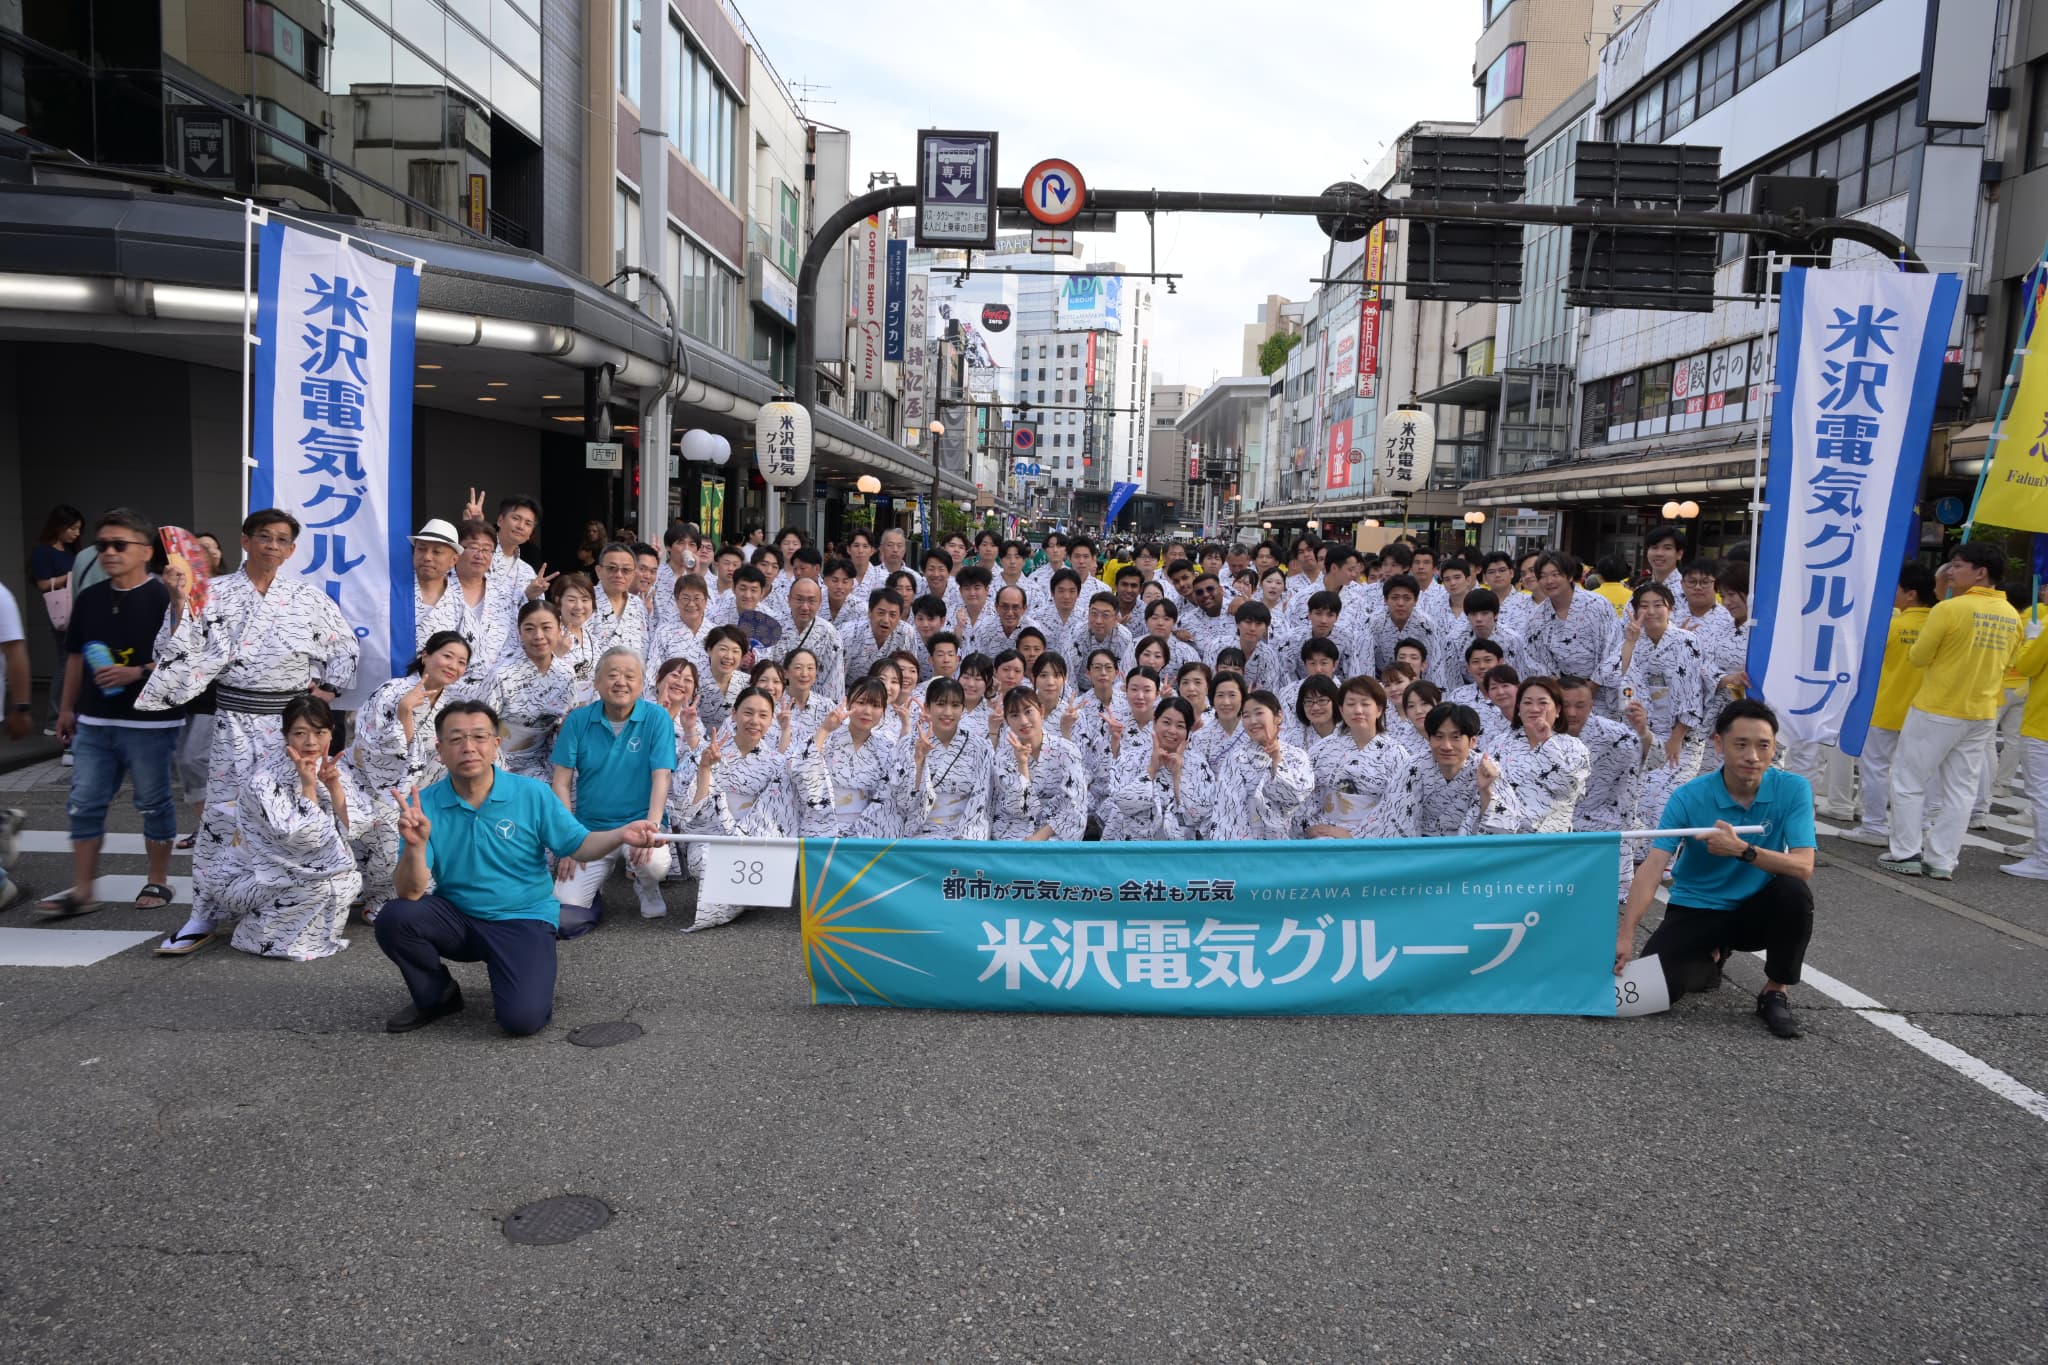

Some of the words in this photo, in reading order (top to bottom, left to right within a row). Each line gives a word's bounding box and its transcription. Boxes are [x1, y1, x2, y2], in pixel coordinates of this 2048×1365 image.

[941, 165, 972, 179] 専用
[867, 231, 877, 281] COFFEE
[866, 283, 876, 316] SHOP
[1061, 277, 1104, 298] APA
[888, 300, 902, 355] ダンカン
[1364, 317, 1376, 371] GAME
[1362, 374, 1372, 382] 2F
[297, 272, 370, 640] 米沢電気グルー
[766, 432, 778, 474] グループ
[780, 415, 795, 476] 米沢電気
[1386, 437, 1398, 478] グループ
[1397, 422, 1417, 482] 米沢電気
[1789, 304, 1901, 716] 米沢電気グループ
[730, 860, 764, 885] 38
[942, 877, 1114, 902] 都市が元気だから
[1118, 879, 1236, 903] 会社も元気
[1249, 886, 1351, 901] YONEZAWA
[1361, 882, 1450, 897] Electrical
[1462, 880, 1576, 898] Engineering
[977, 911, 1540, 991] 米沢電気グループ
